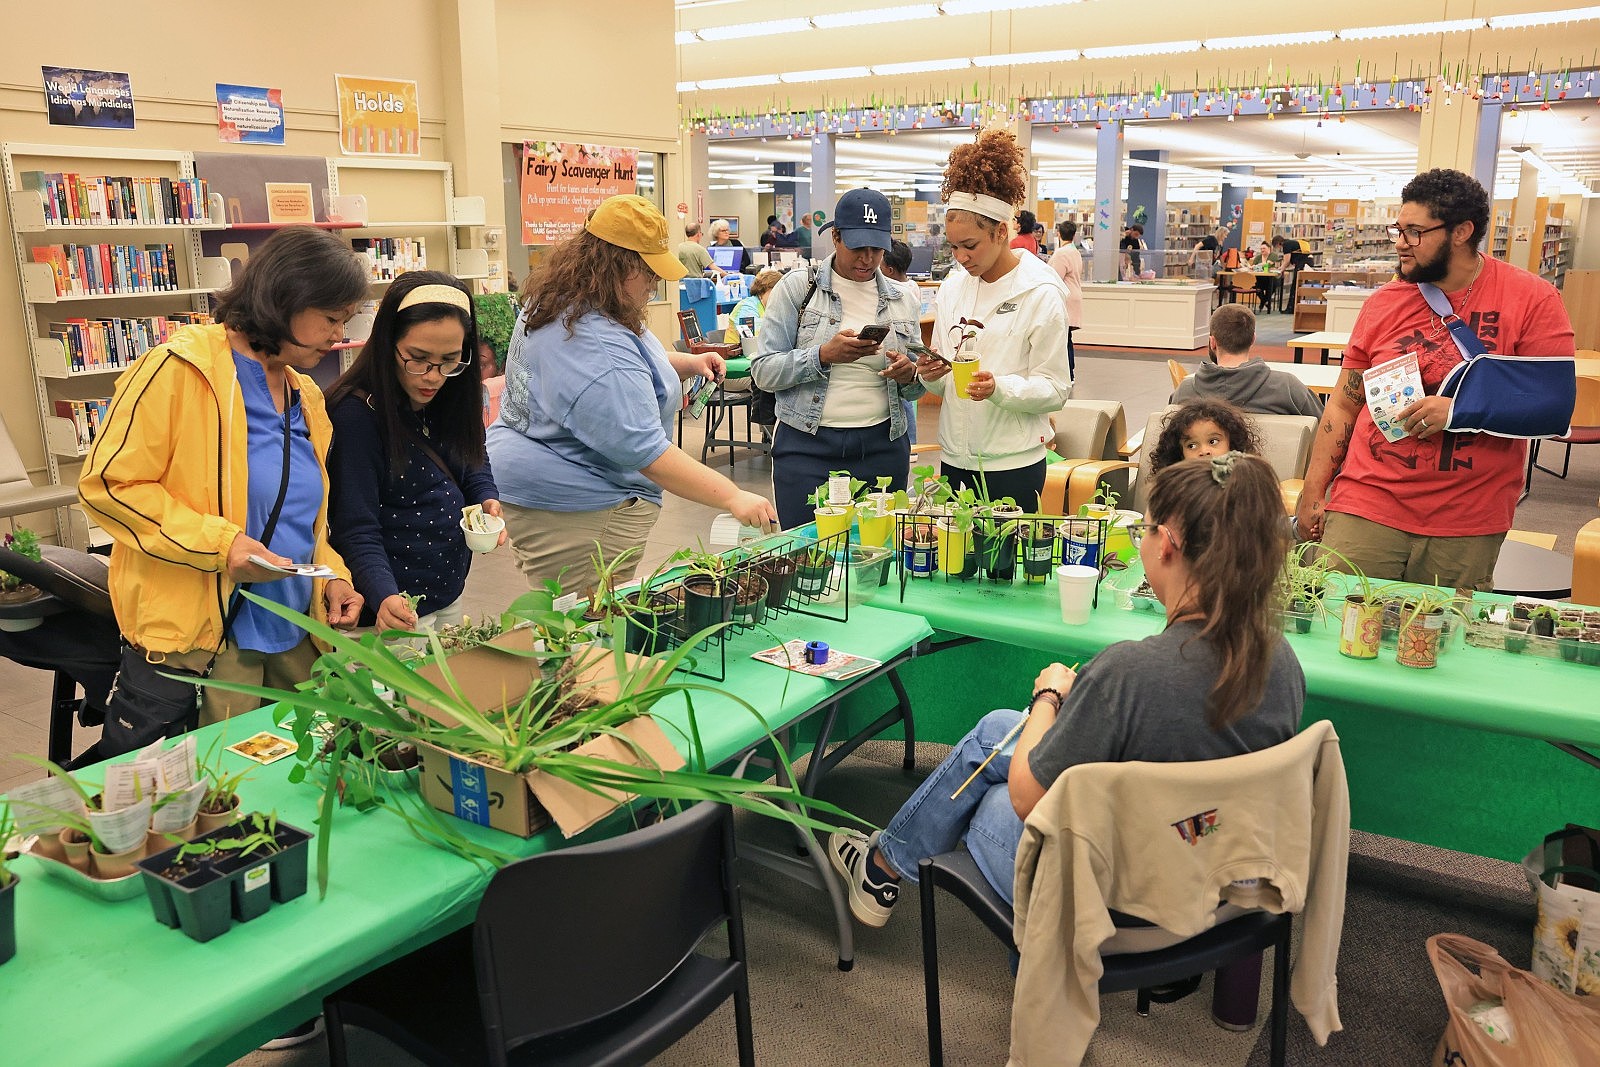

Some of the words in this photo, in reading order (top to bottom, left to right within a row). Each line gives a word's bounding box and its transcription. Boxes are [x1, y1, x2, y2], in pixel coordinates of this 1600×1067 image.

[46, 81, 77, 93] World
[80, 84, 130, 98] Languages
[51, 95, 87, 107] Idiomas
[89, 98, 132, 110] Mundiales
[353, 91, 404, 113] Holds
[527, 157, 557, 184] Fairy
[562, 159, 611, 186] Scavenger
[613, 163, 634, 181] Hunt
[527, 192, 538, 205] Pick
[538, 197, 545, 207] up
[863, 203, 878, 224] LA
